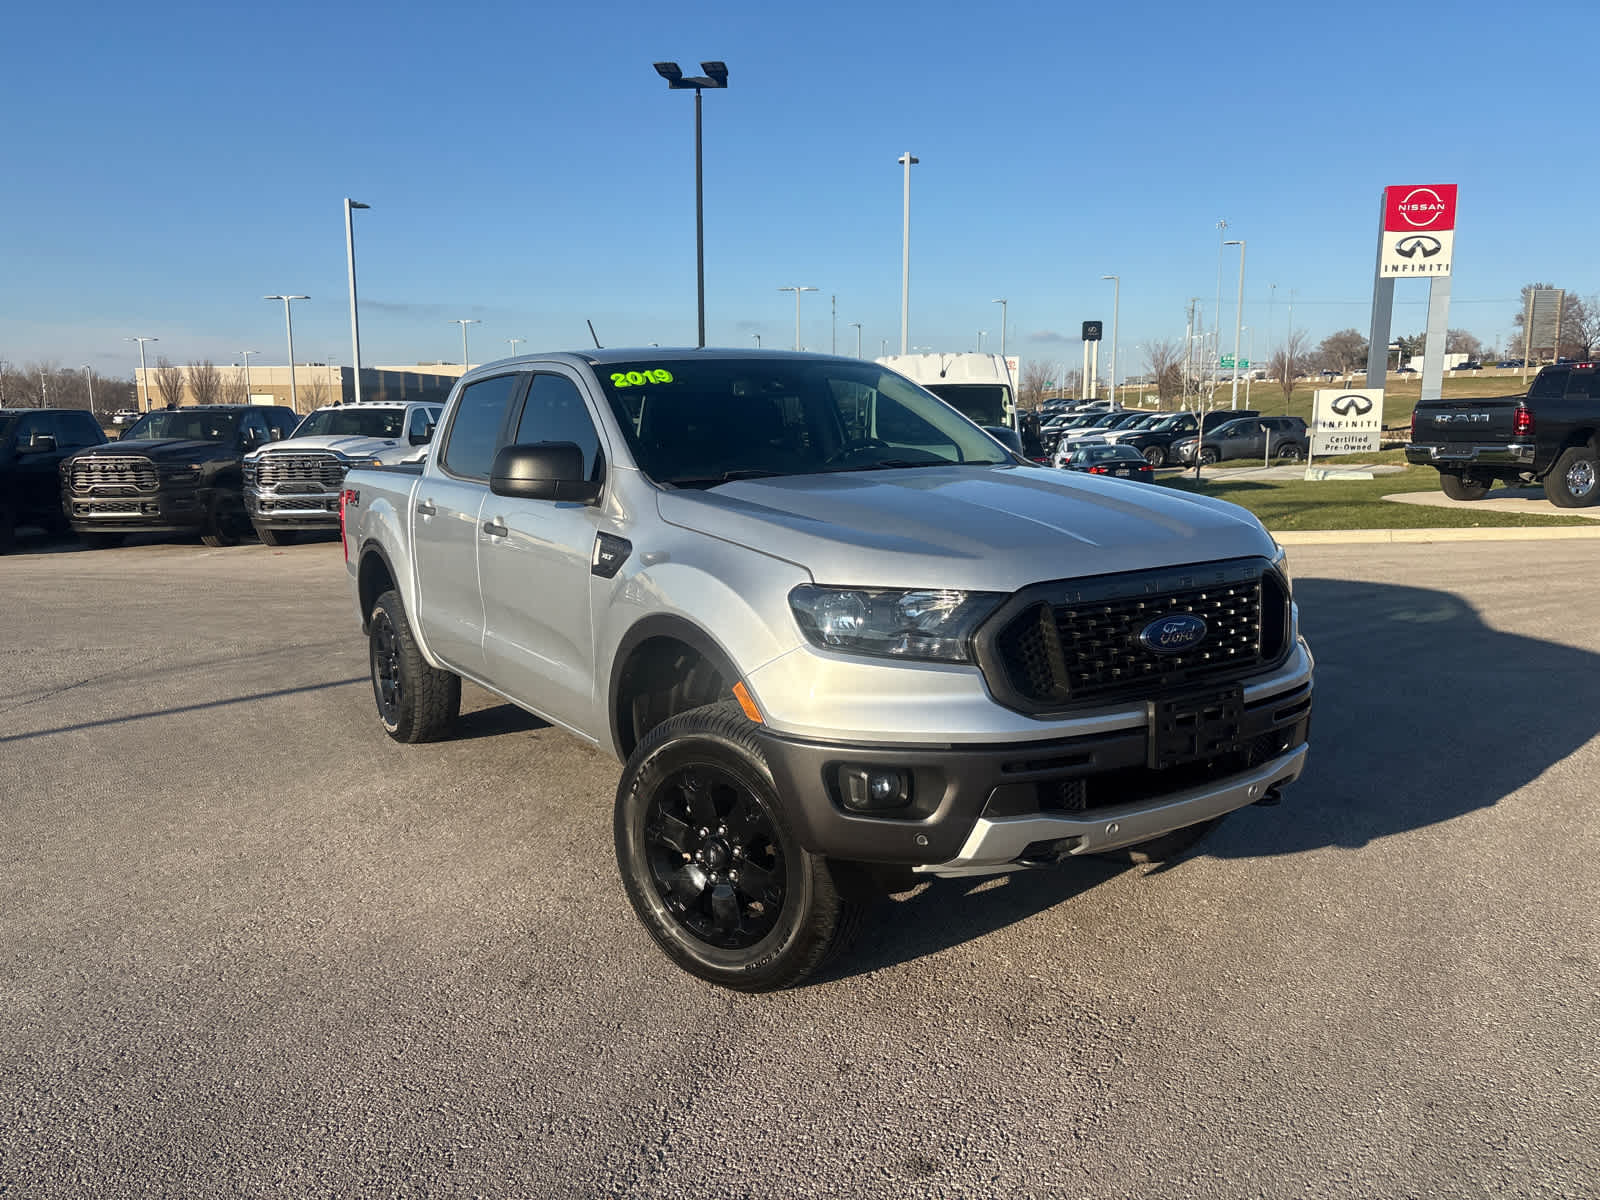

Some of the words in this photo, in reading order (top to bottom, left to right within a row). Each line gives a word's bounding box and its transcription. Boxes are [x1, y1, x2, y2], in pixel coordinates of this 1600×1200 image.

[1385, 264, 1449, 272] INFINITI
[610, 369, 673, 387] 2019
[1434, 414, 1489, 422] RAM
[1330, 435, 1368, 443] Certified
[1160, 621, 1195, 644] Ford
